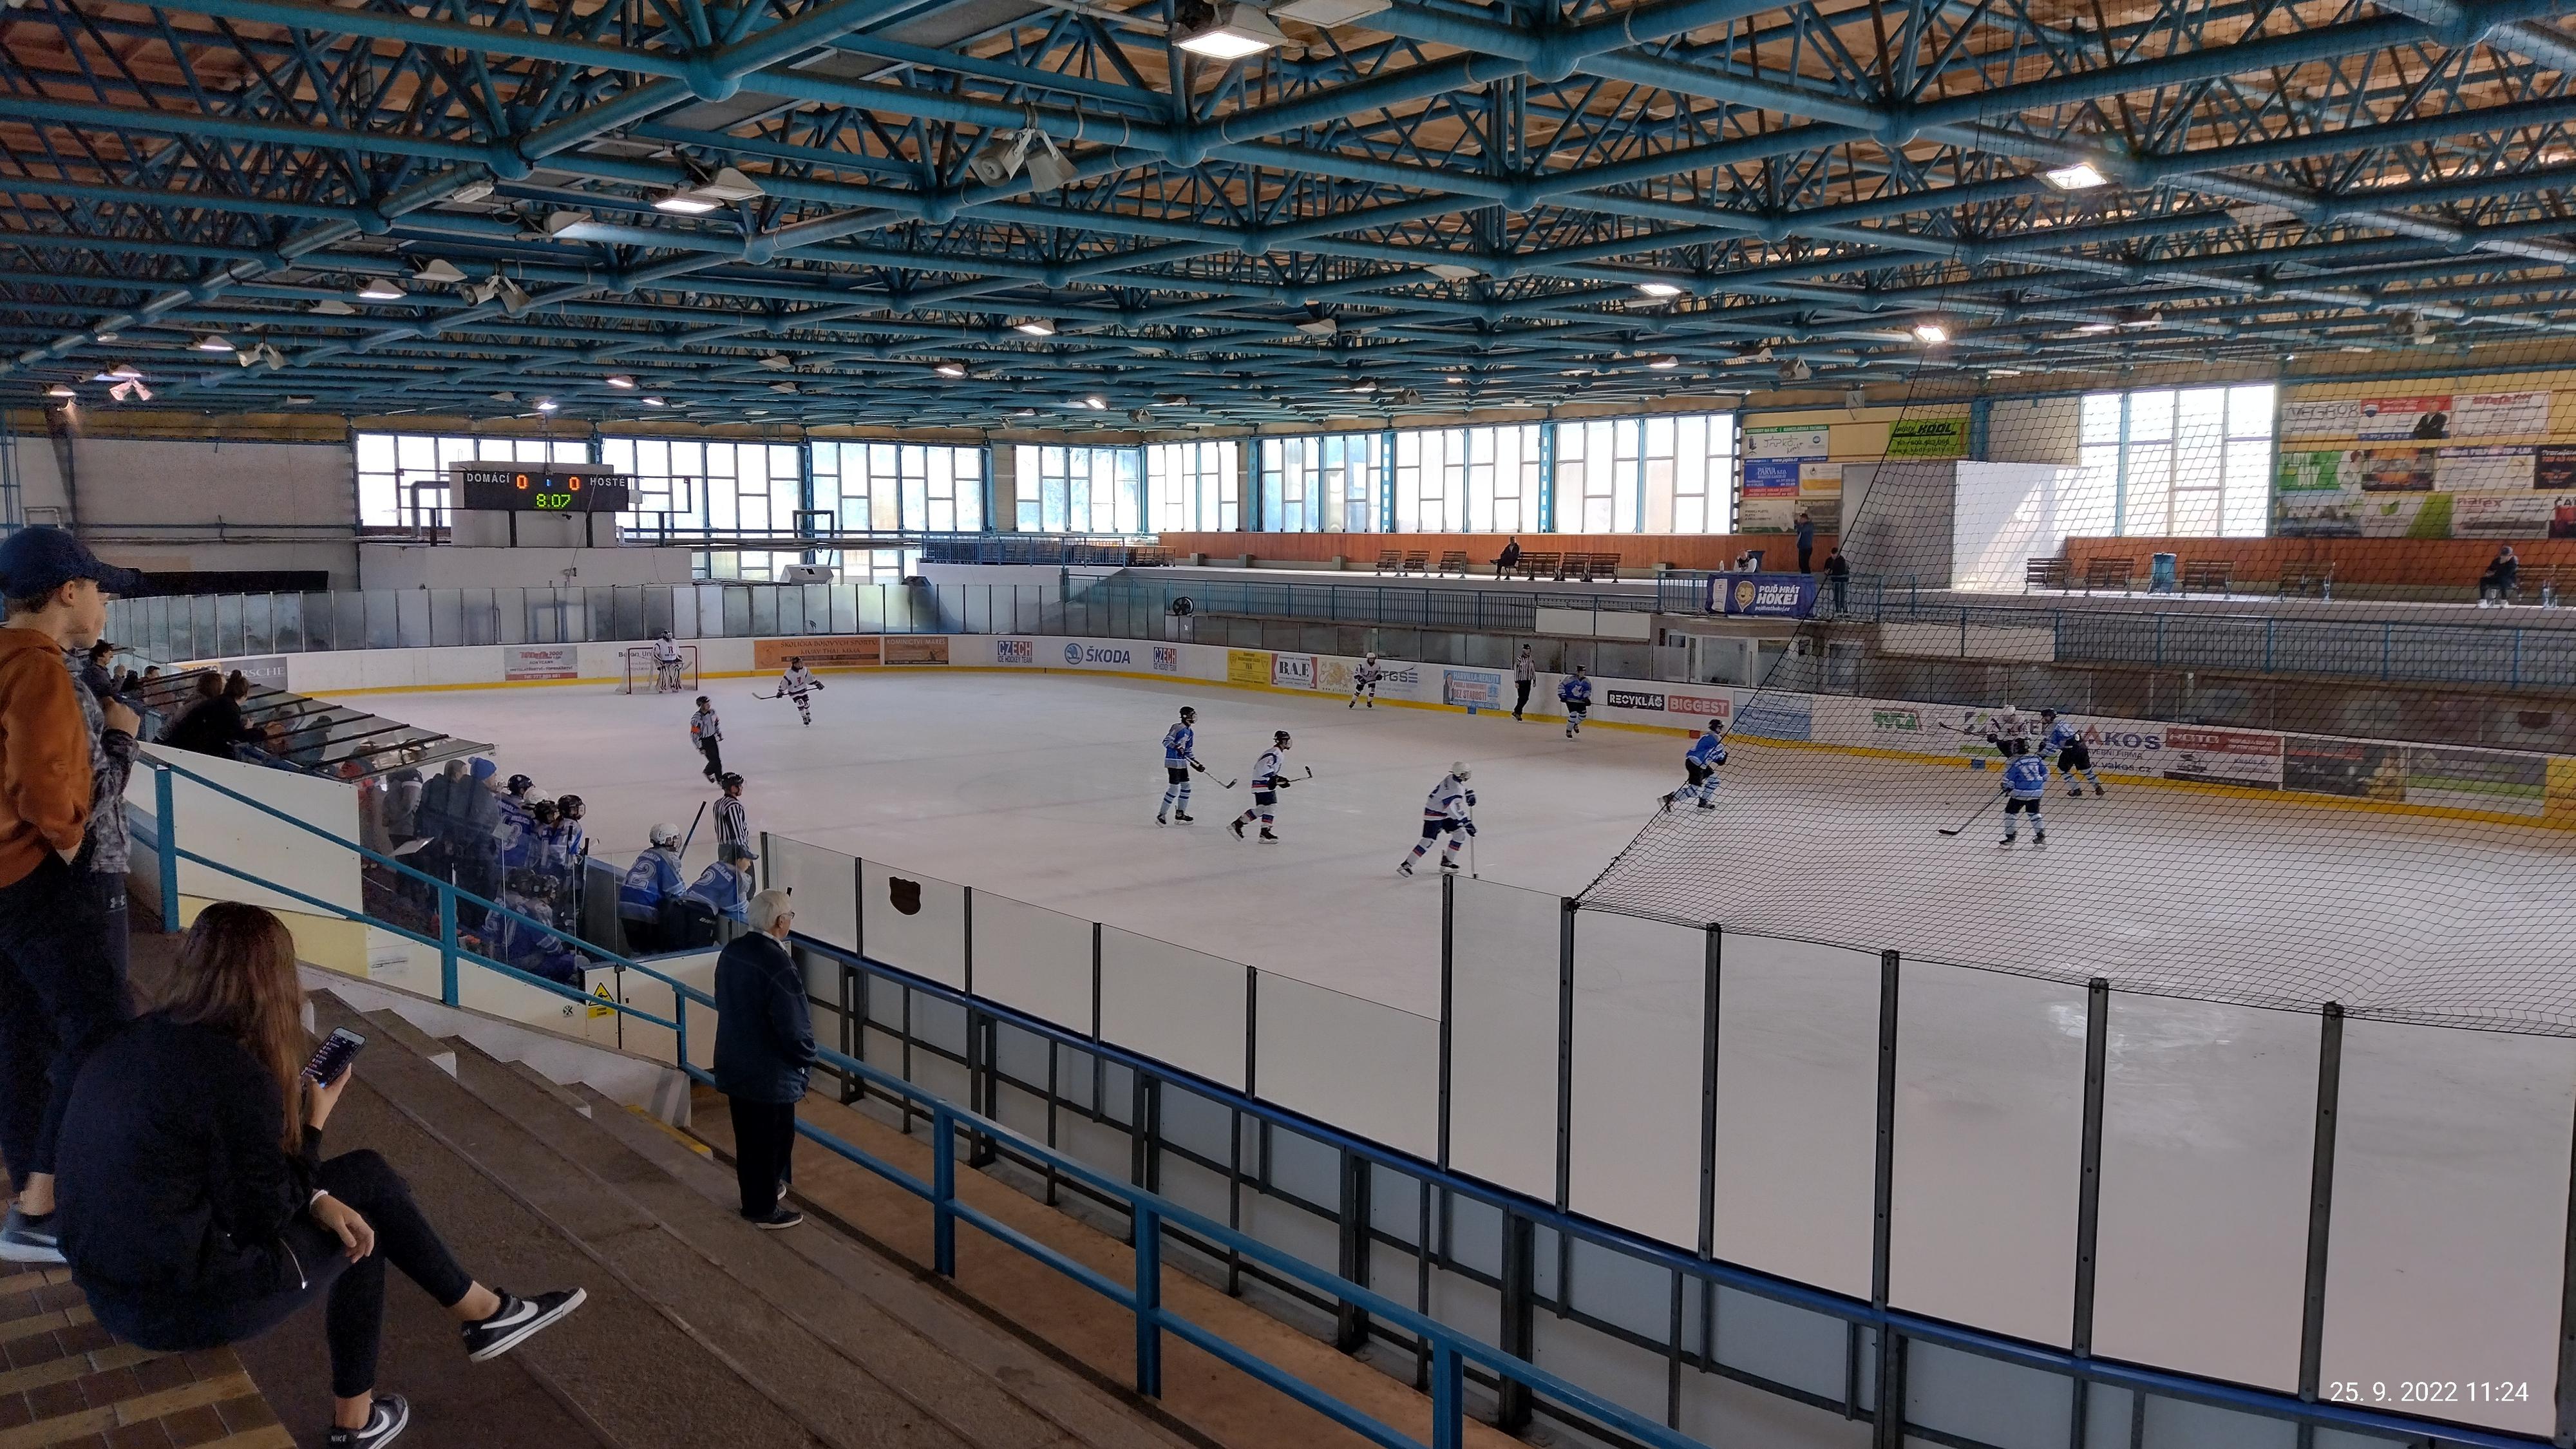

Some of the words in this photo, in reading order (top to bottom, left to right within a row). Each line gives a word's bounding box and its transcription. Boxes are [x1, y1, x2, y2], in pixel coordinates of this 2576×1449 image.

[1757, 467, 1776, 475] PARVA
[467, 473, 509, 483] DOMÁCÍ
[517, 475, 528, 489] 0
[569, 477, 580, 491] 0
[590, 476, 625, 487] HOSTÉ
[1759, 584, 1777, 593] POJĎ
[1779, 584, 1801, 594] HRÁT
[1756, 593, 1799, 605] HOKEJ
[998, 641, 1032, 656] CZECH
[1086, 646, 1131, 664] ŠKODA
[1154, 647, 1177, 664] CZECH
[223, 667, 285, 677] PRSCHE
[1669, 697, 1728, 715] BIGGEST
